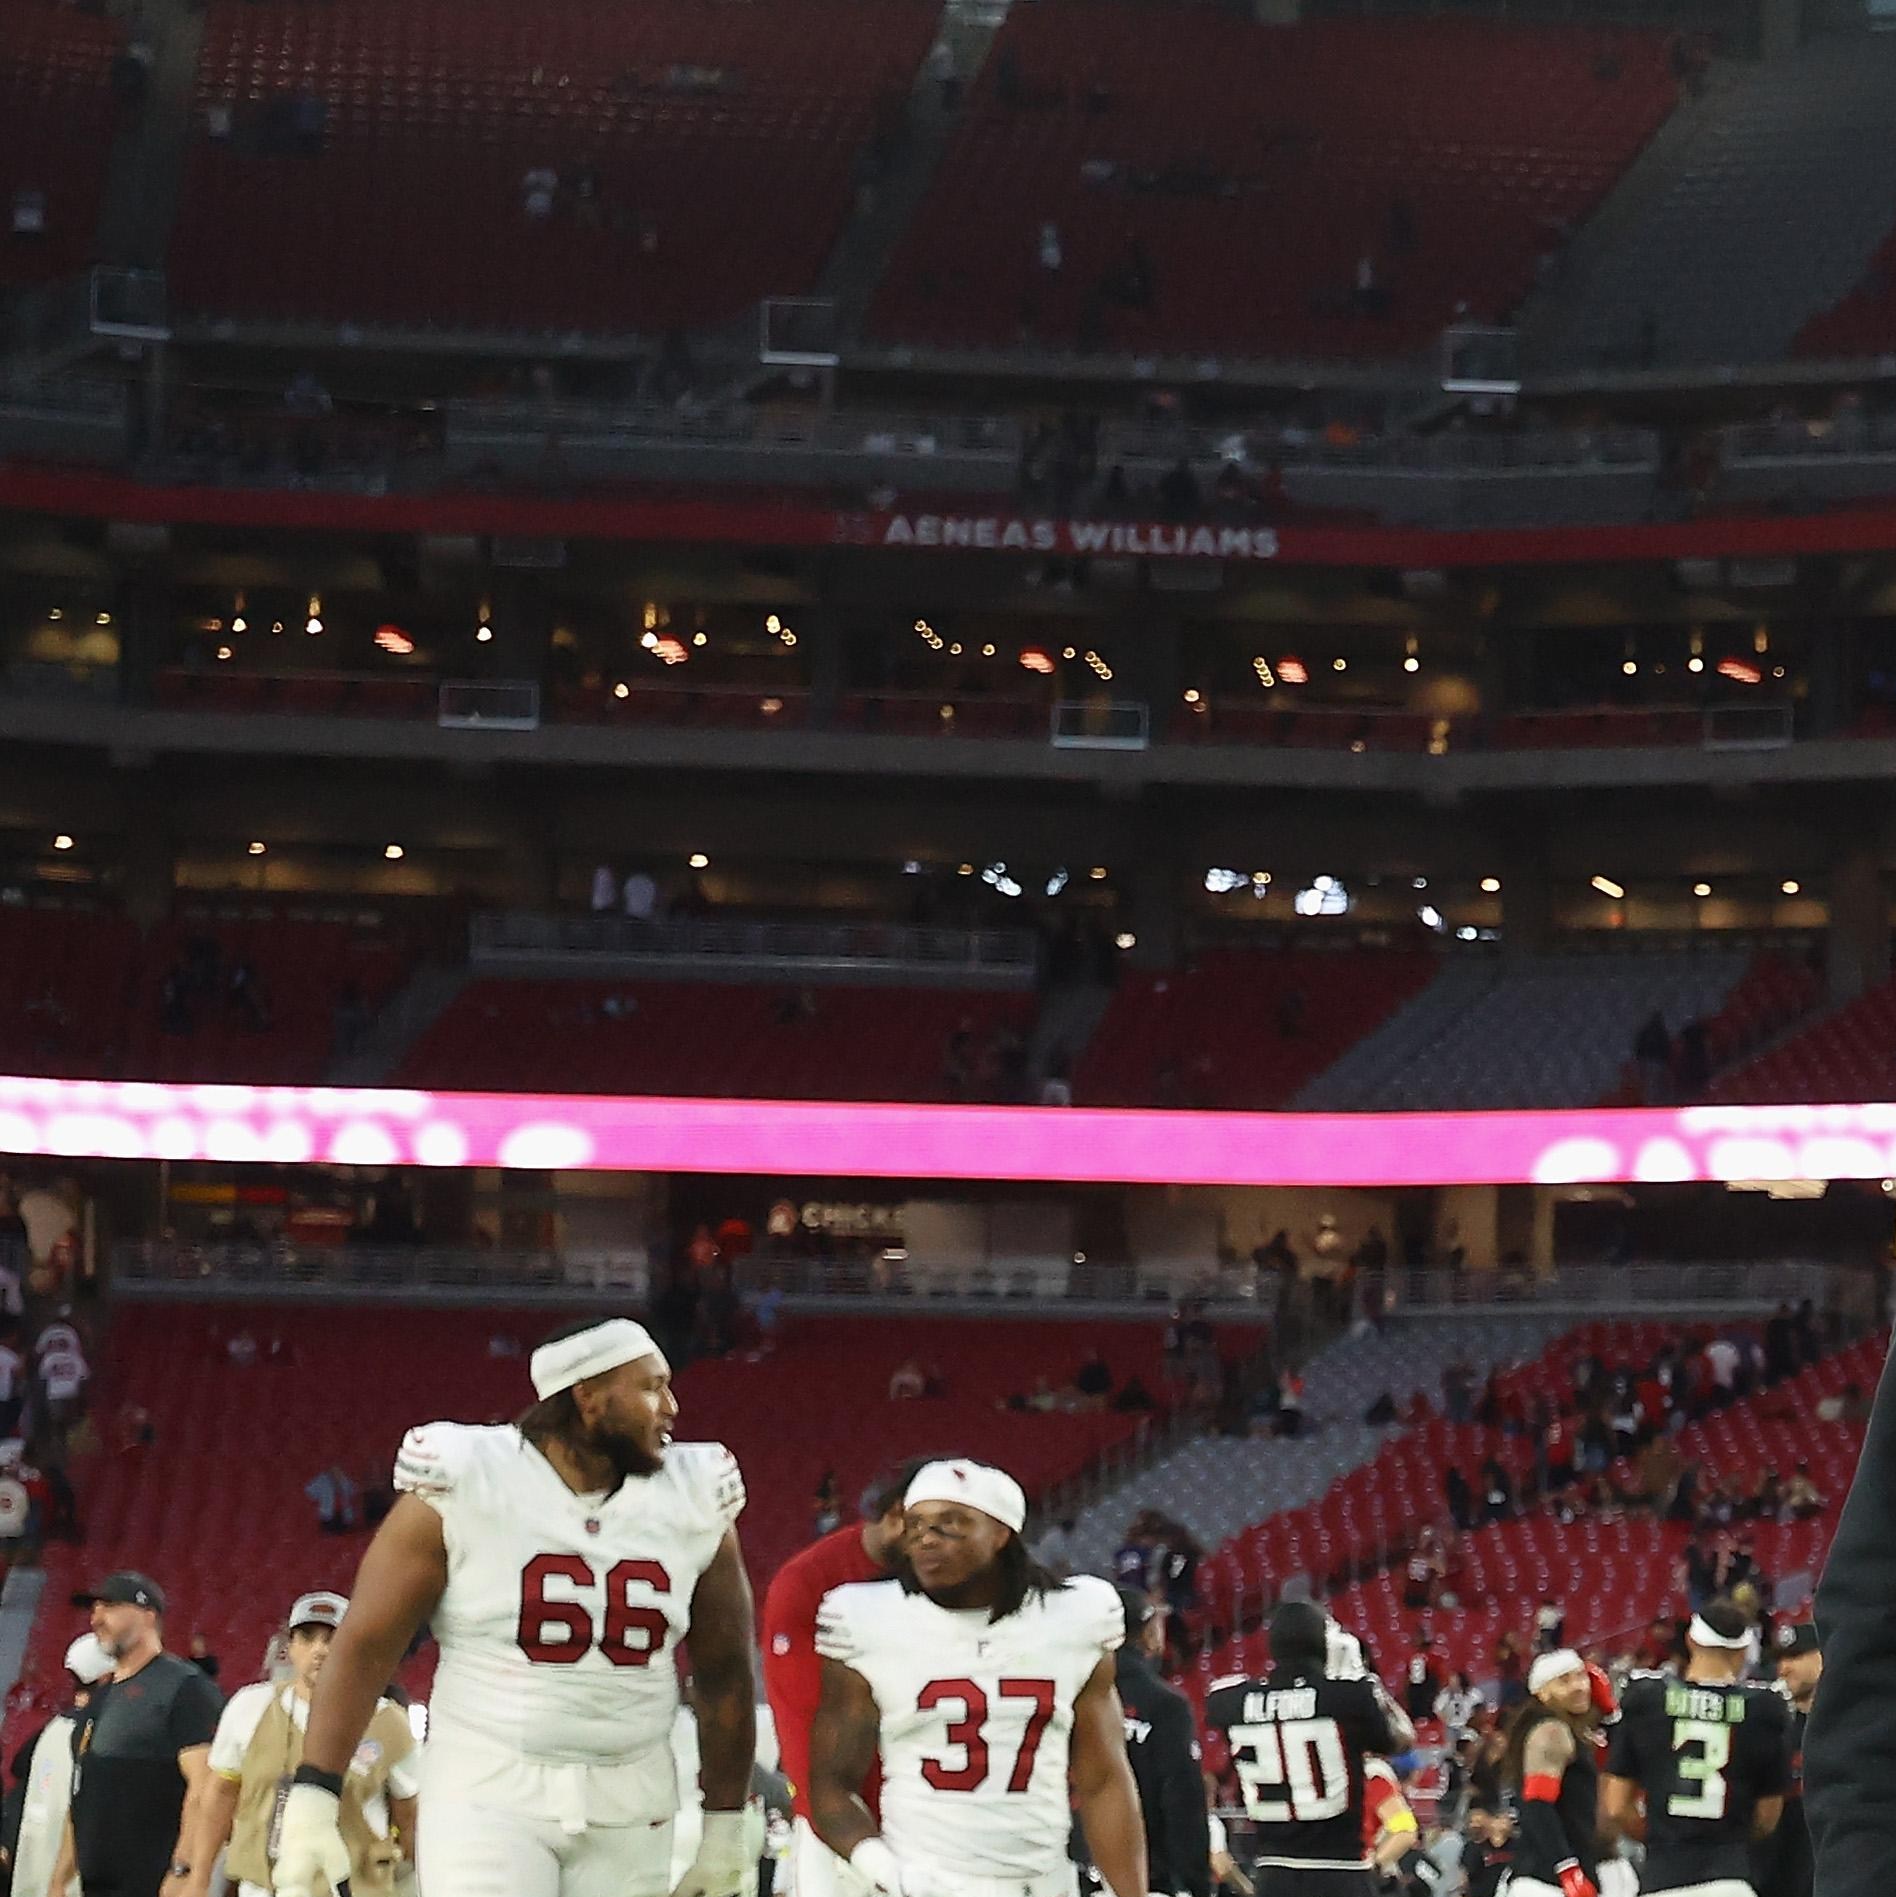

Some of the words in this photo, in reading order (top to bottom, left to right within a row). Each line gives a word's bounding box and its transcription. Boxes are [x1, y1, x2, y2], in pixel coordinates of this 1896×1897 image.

[884, 513, 1058, 552] AENEAS
[1069, 520, 1281, 559] WILLIAMS
[516, 1553, 672, 1667] 66
[916, 1678, 1056, 1793] 37
[1227, 1716, 1350, 1823] 20
[1667, 1718, 1732, 1821] 3
